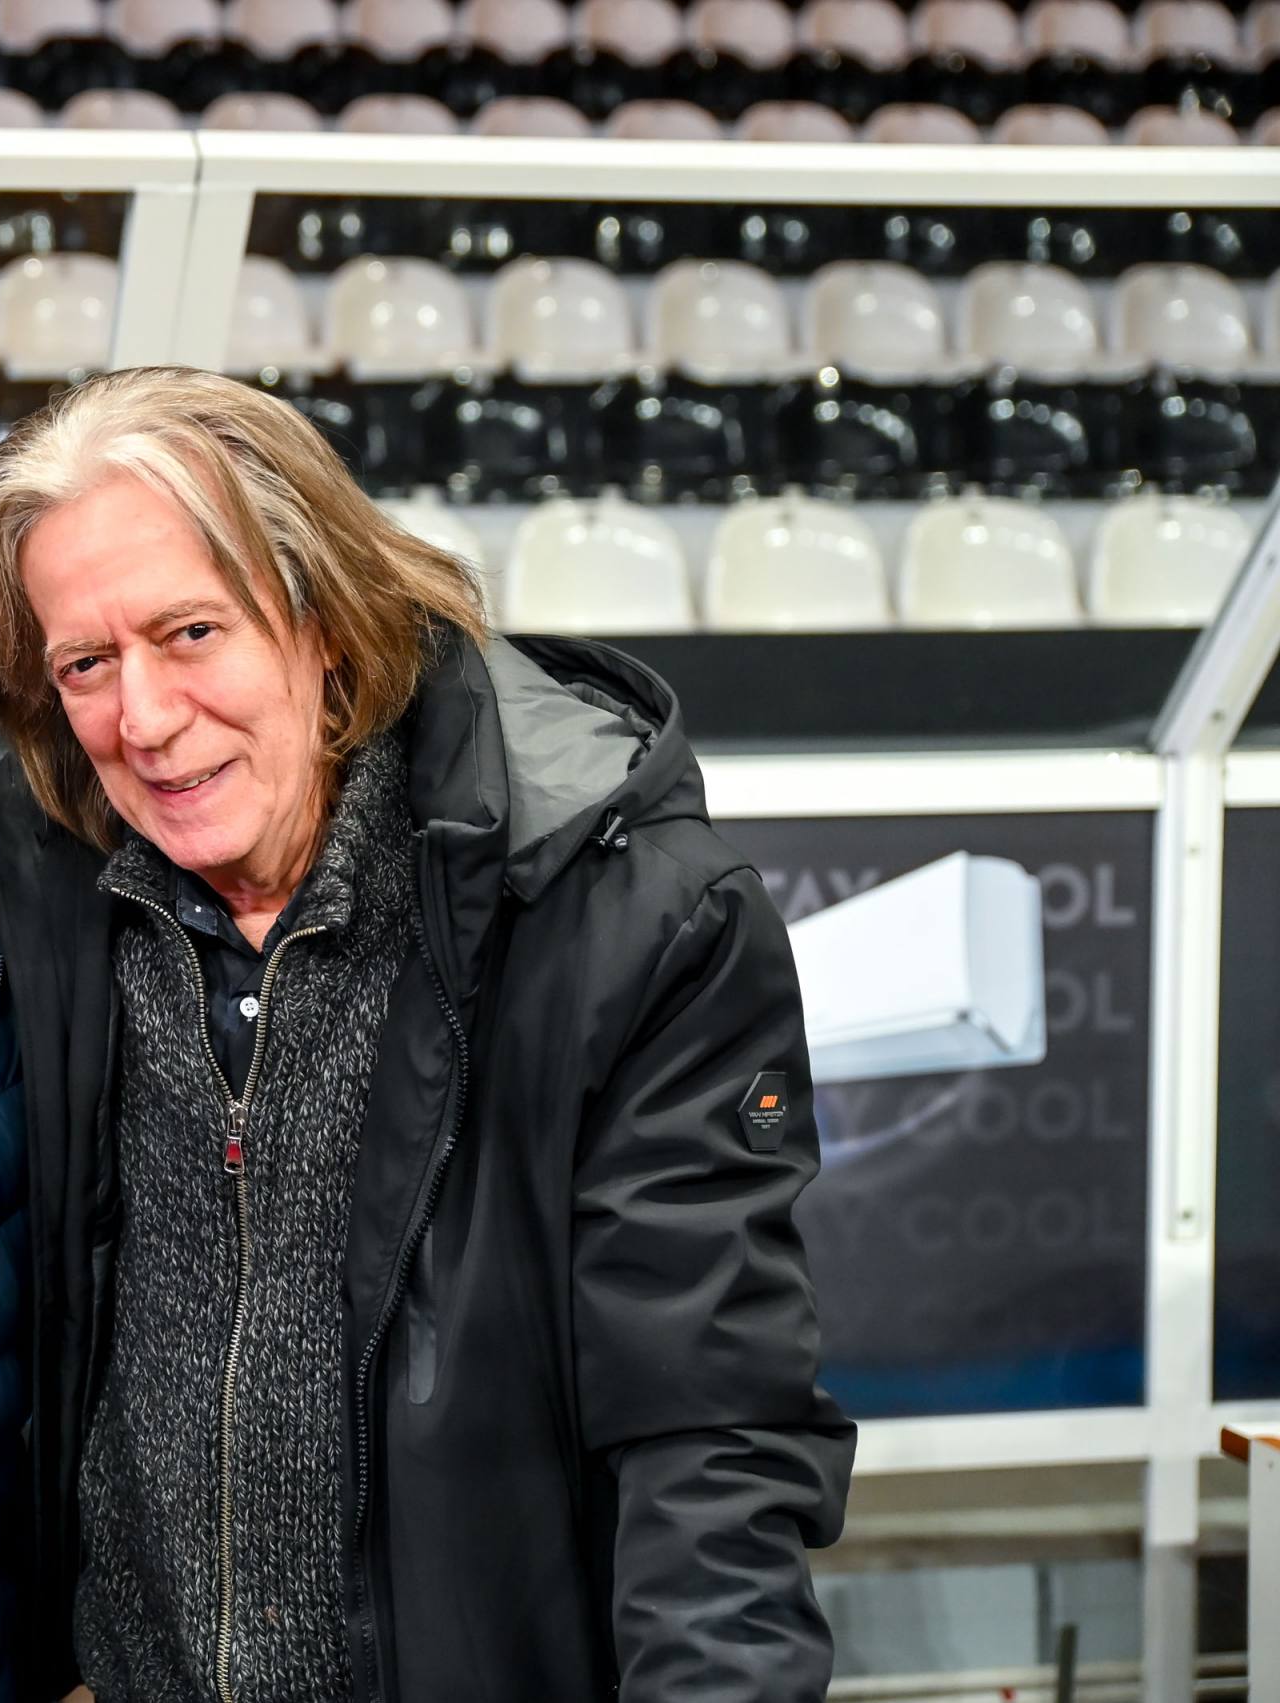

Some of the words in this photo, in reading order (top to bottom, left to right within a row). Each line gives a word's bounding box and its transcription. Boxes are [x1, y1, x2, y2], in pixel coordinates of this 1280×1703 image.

[760, 867, 879, 924] AY
[1039, 862, 1137, 927] OL
[1047, 969, 1136, 1033] OL
[898, 1079, 1132, 1147] COOL
[898, 1186, 1130, 1252] COOL
